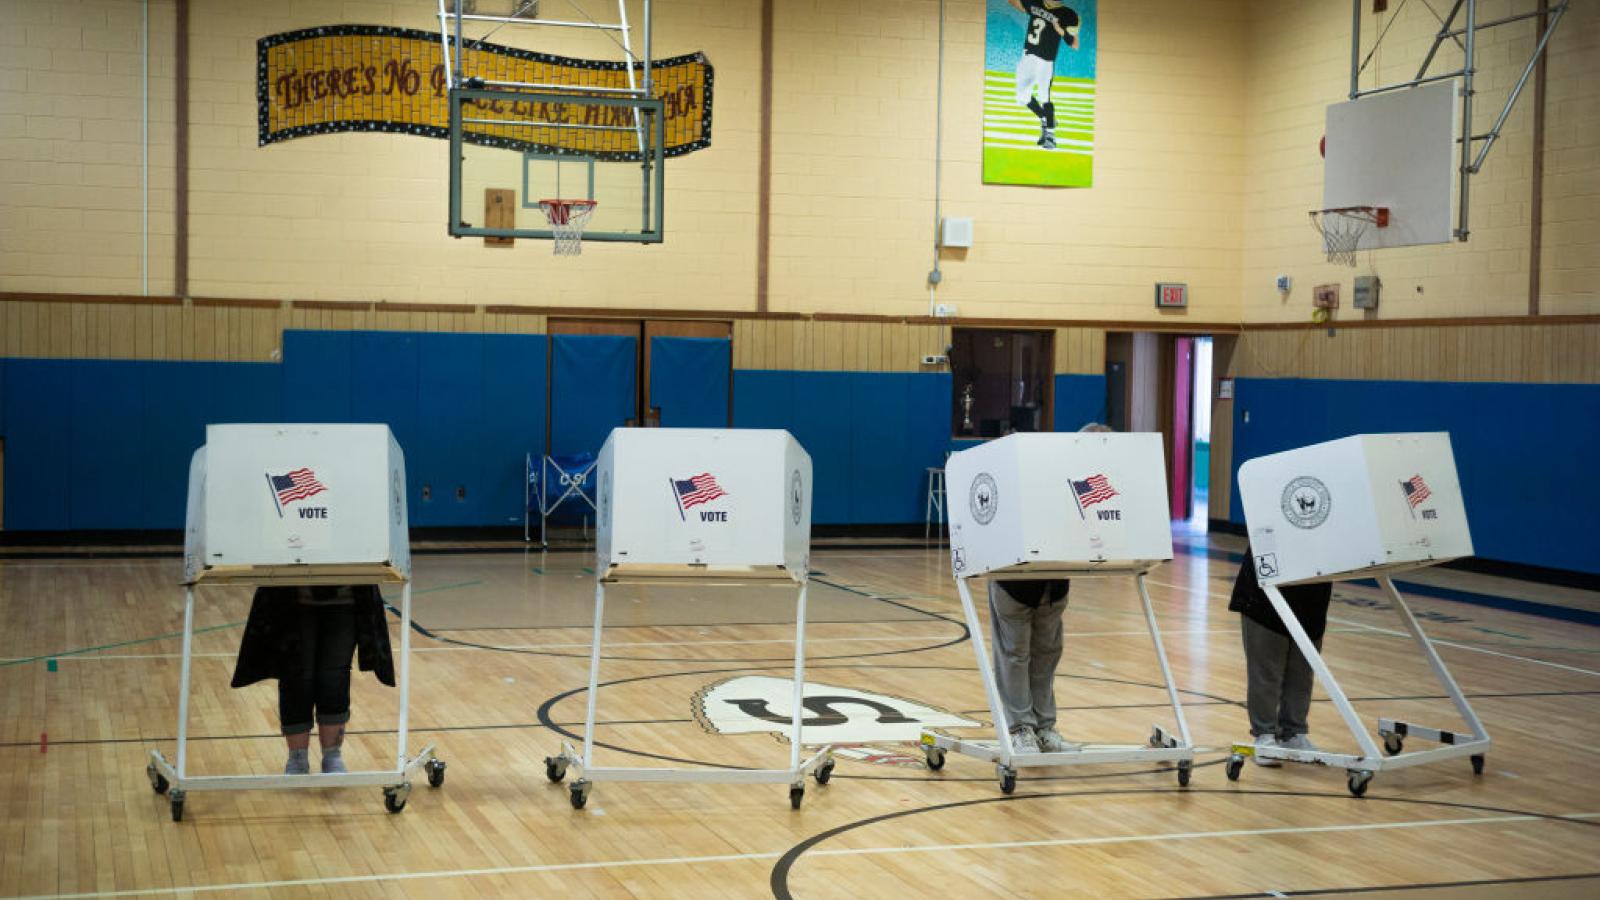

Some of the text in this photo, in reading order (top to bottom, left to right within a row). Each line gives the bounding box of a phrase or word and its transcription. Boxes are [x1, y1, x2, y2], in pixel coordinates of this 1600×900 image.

[1028, 18, 1046, 45] 3
[276, 61, 377, 108] THERE'S
[1163, 287, 1185, 305] EXIT
[298, 506, 328, 519] VOTE
[700, 511, 728, 522] VOTE
[1096, 509, 1121, 521] VOTE
[1422, 507, 1438, 519] VOTE
